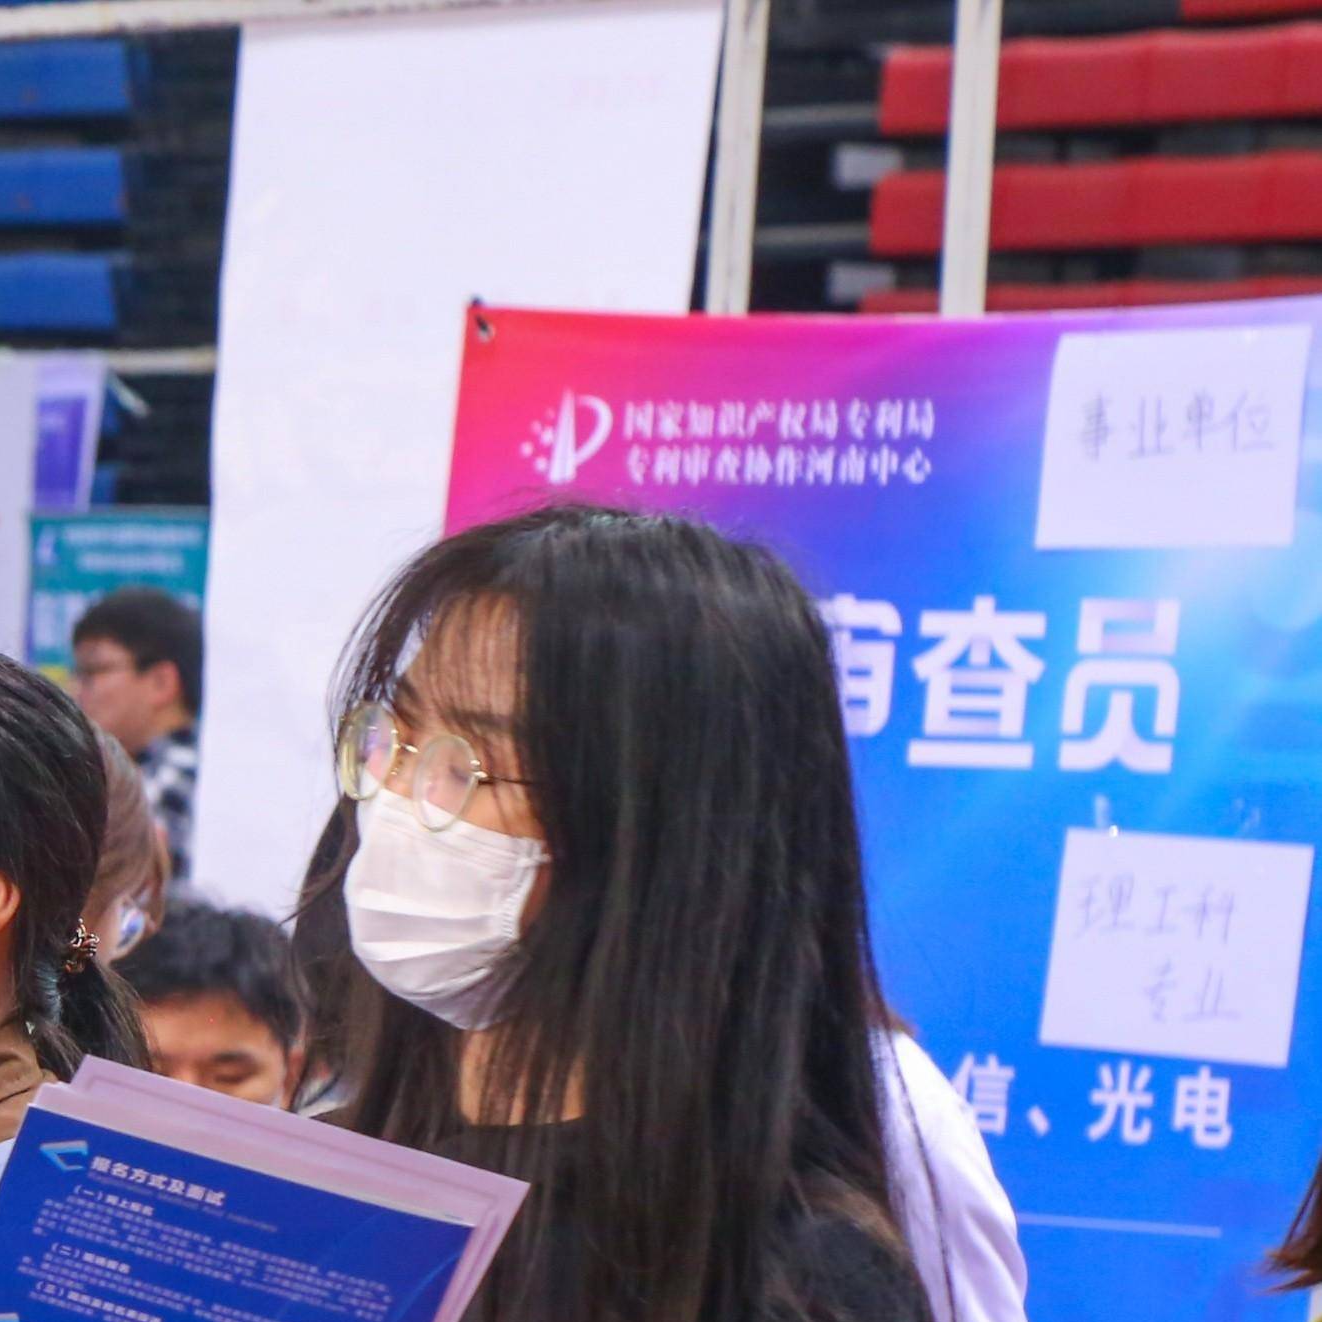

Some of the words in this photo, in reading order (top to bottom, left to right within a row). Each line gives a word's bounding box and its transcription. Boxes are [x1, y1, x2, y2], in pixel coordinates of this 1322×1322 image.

[623, 397, 935, 441] 国家知识产权局专利局
[1079, 388, 1276, 461] 事业单位
[626, 444, 933, 486] 专利审查协作河南中心
[1074, 872, 1236, 944] 理工科
[1142, 957, 1242, 1023] 专业
[90, 1154, 227, 1208] 报名方式及面试
